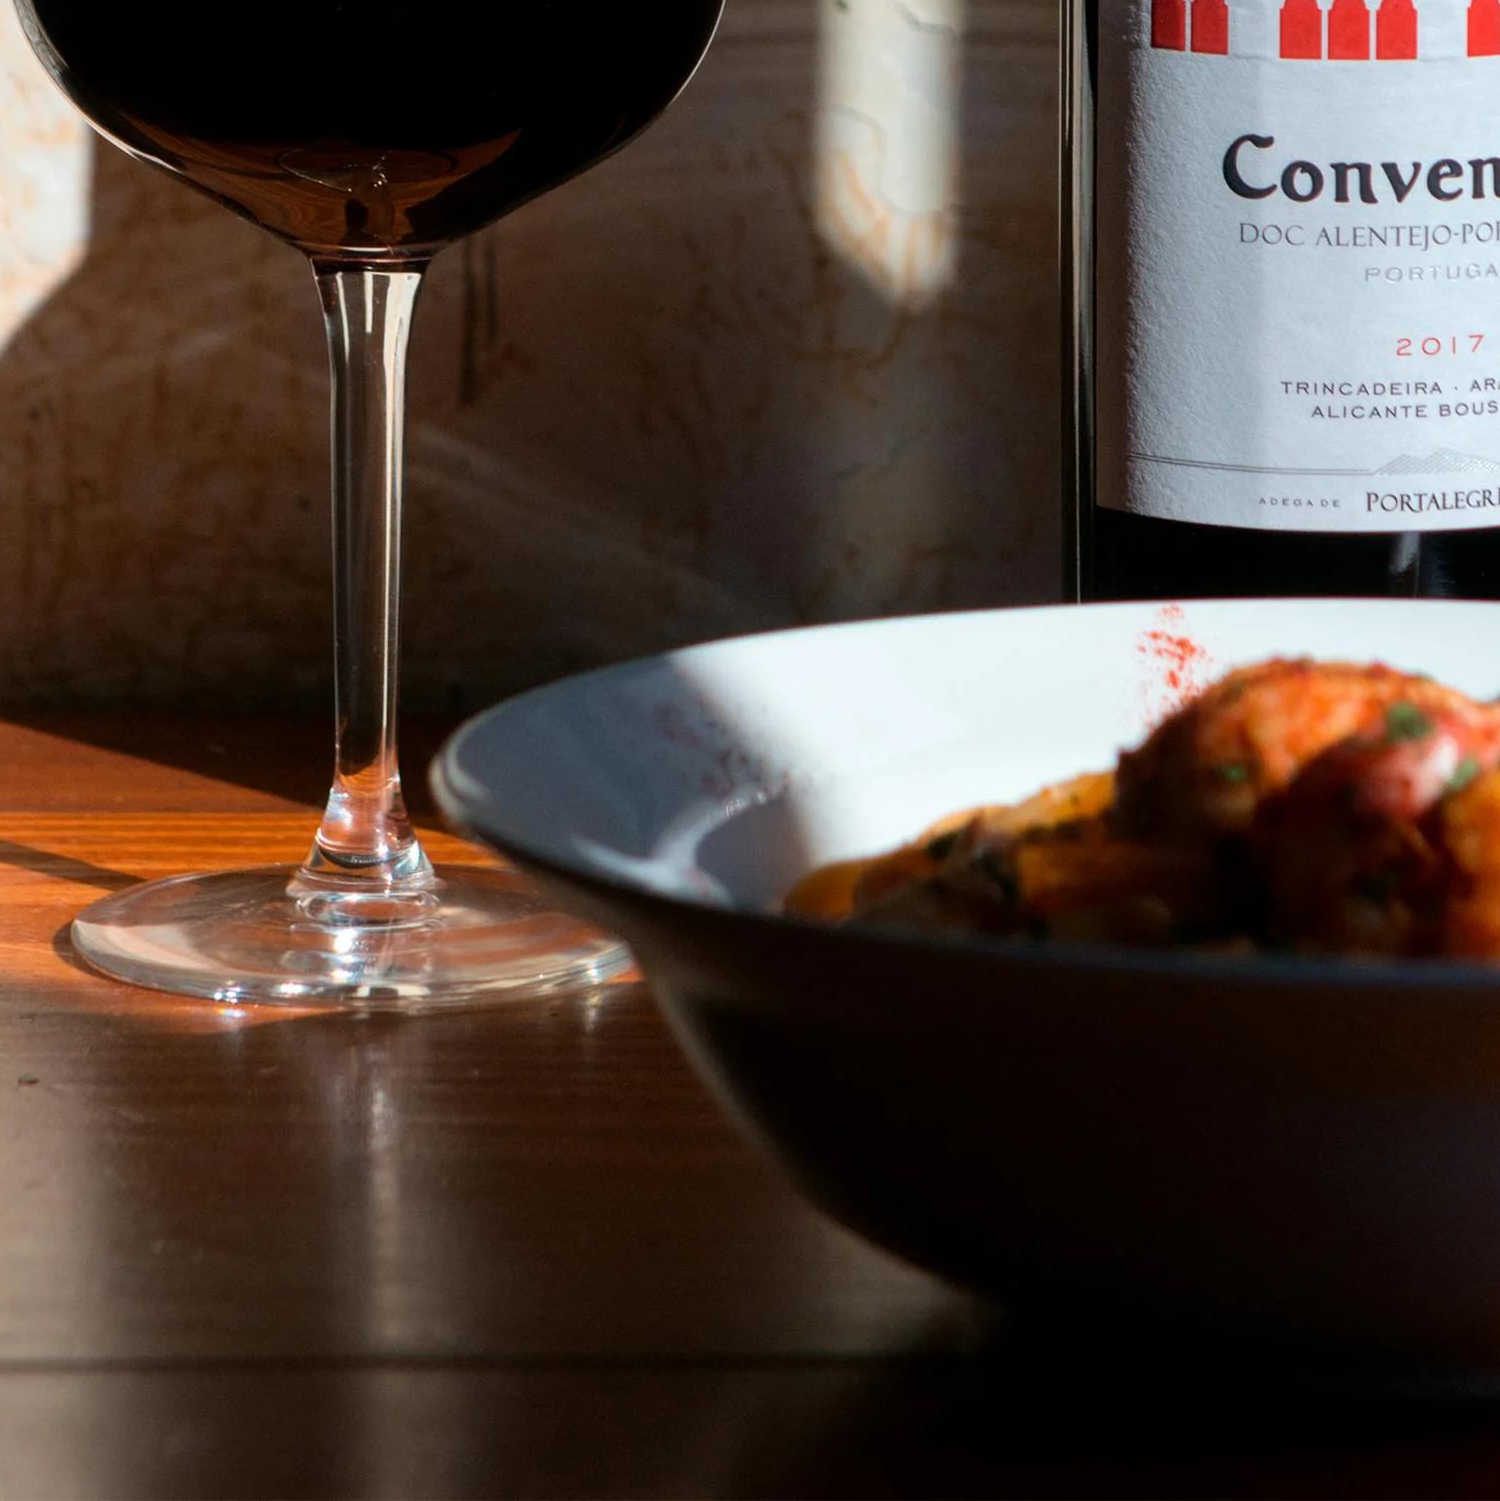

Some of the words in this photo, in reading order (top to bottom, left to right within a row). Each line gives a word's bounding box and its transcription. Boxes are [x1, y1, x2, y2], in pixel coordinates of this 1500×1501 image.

[1239, 222, 1306, 246] DOC
[1395, 334, 1485, 357] 2017
[1280, 381, 1443, 396] TRINCADEIRA
[1311, 405, 1429, 420] ALICANTE
[1258, 497, 1314, 507] ADEGA
[1320, 499, 1341, 508] DE
